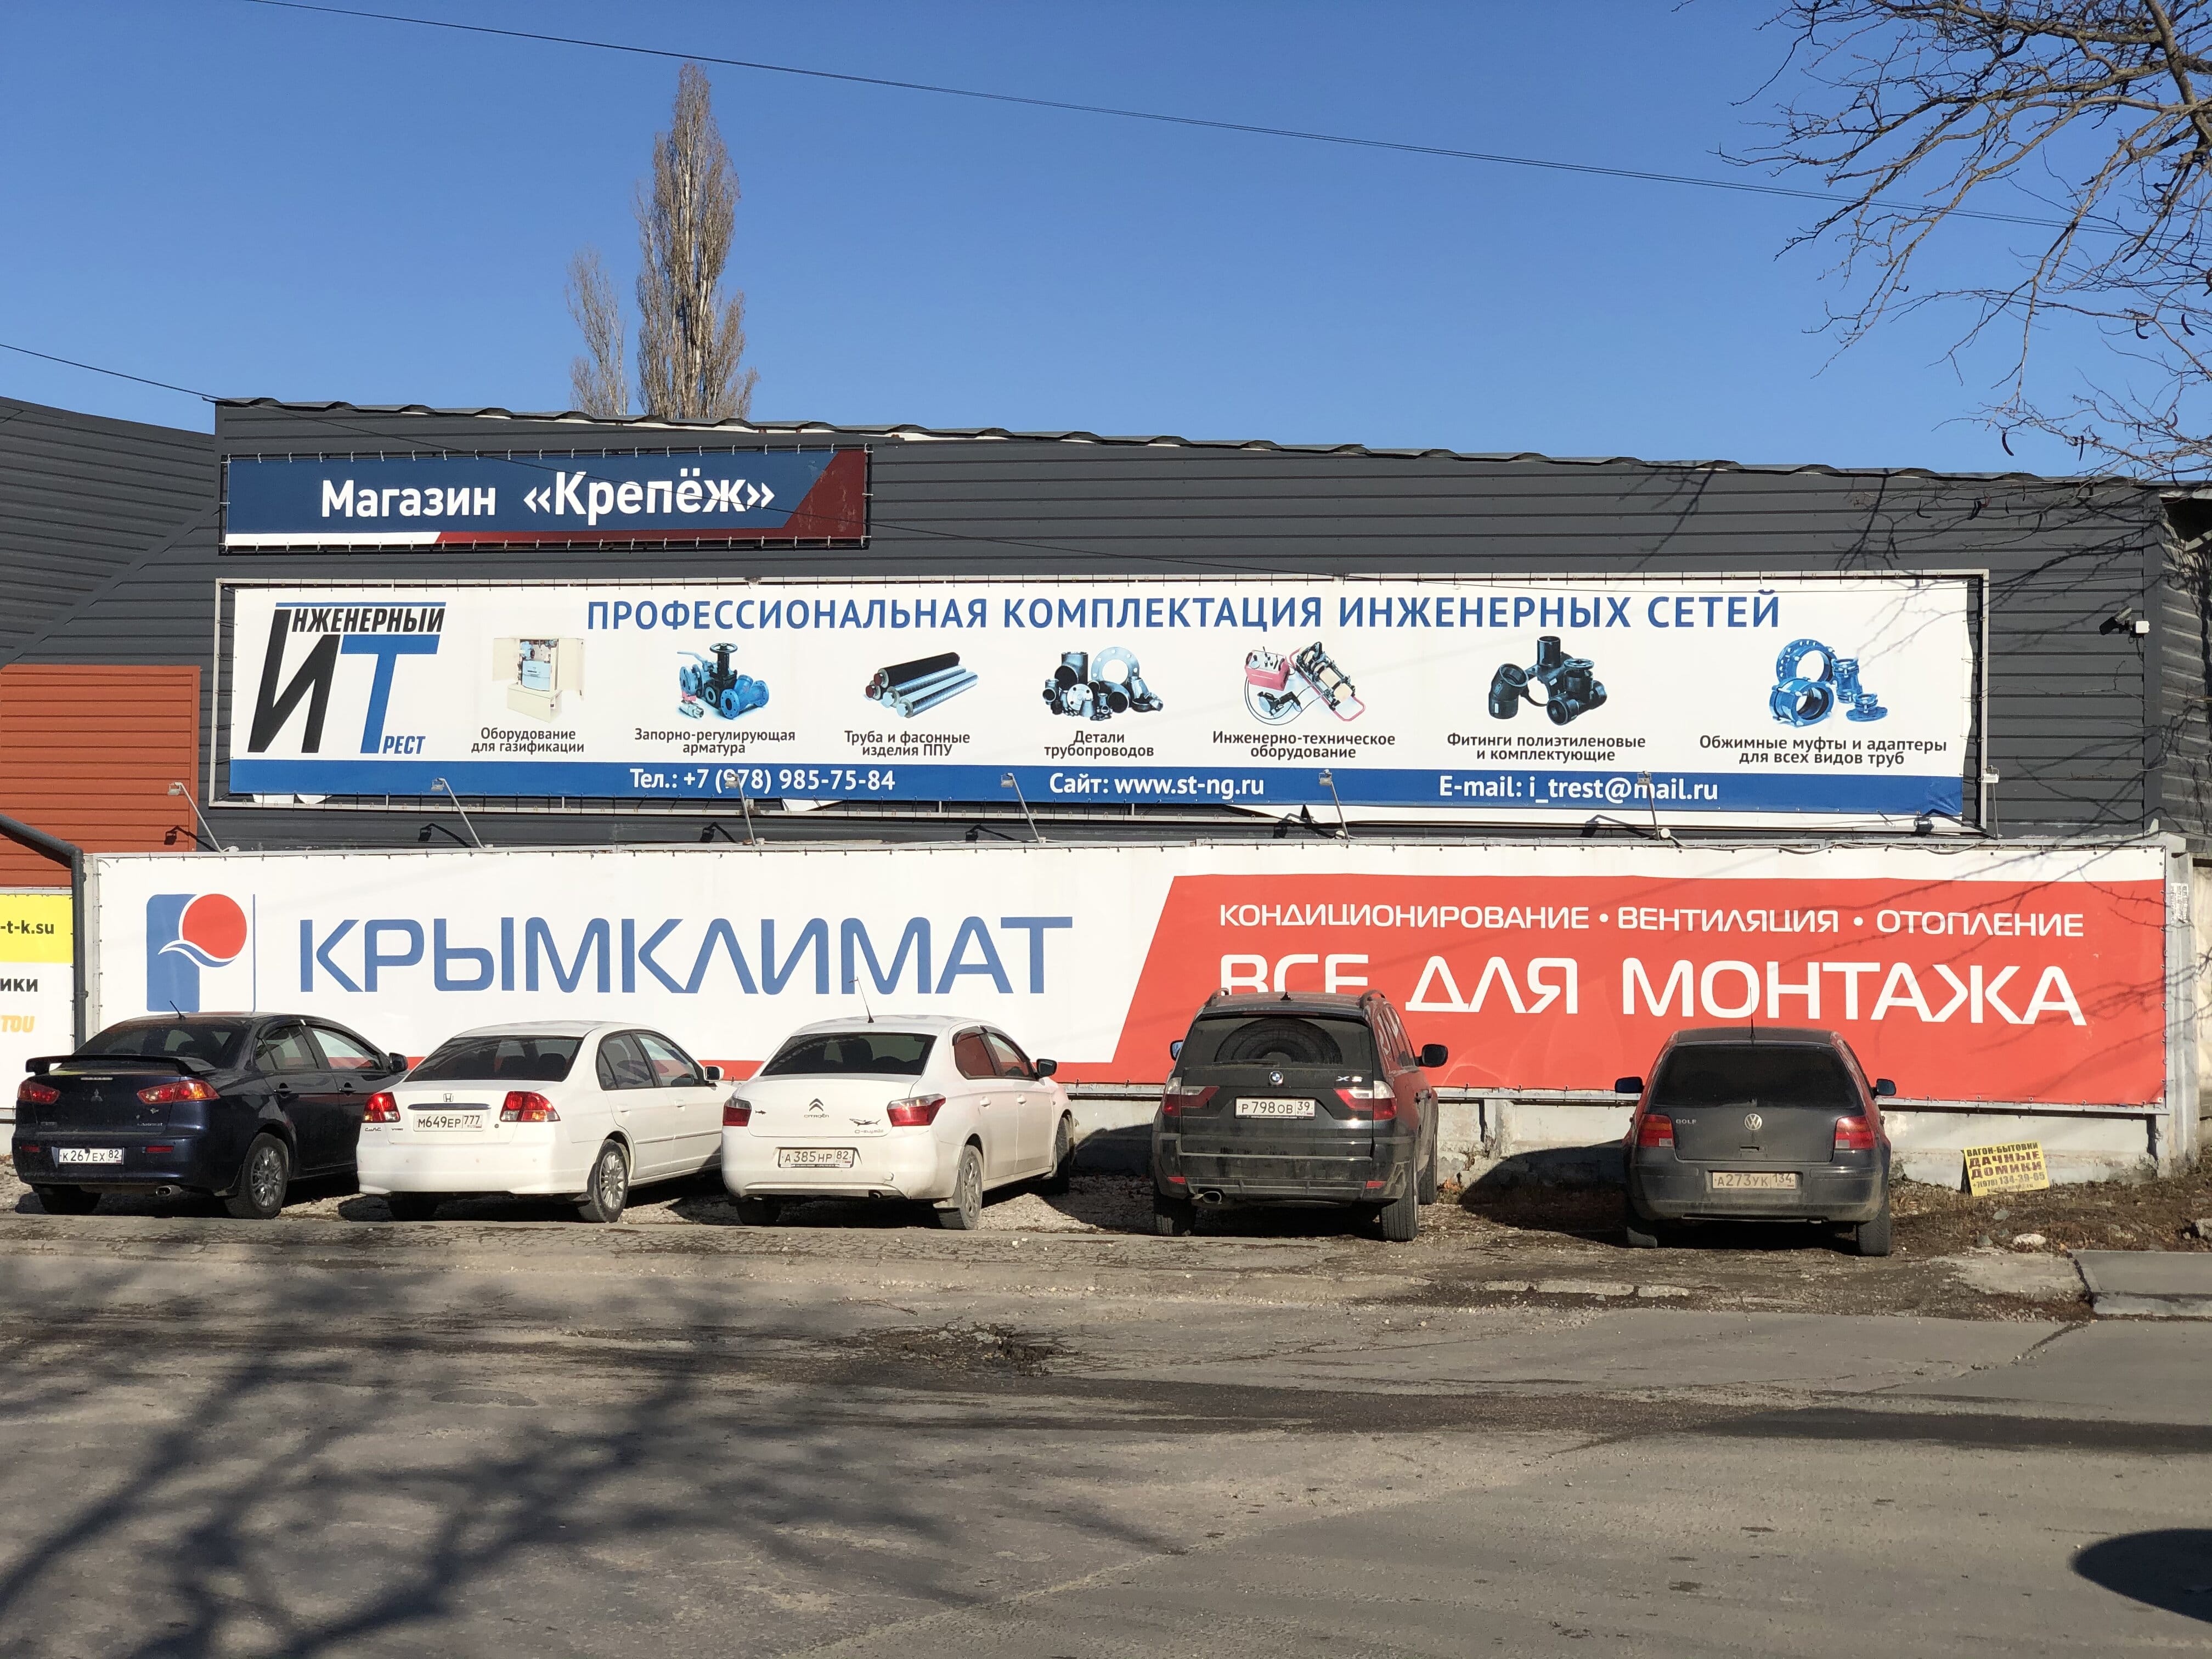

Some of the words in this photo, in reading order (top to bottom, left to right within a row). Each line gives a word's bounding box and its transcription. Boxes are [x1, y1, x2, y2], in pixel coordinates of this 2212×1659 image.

[321, 479, 495, 517] Магазин
[524, 468, 774, 525] «Крепёж»
[587, 599, 986, 630] ПРОФЕССИОНАЛЬНАЯ
[1004, 597, 1321, 632] КОМПЛЕКТАЦИЯ
[1340, 596, 1631, 628] ИНЖЕНЕРНЫХ
[1647, 589, 1779, 628] СЕТЕЙ
[481, 727, 576, 743] Оборудование
[635, 727, 795, 743] Запорно-регулирующая
[844, 730, 883, 746] Труба
[888, 734, 895, 743] и
[900, 730, 970, 747] фасонные
[1074, 730, 1125, 745] Детали
[1213, 731, 1395, 747] Инженерно-техническое
[1447, 732, 1511, 747] Фитинги
[1517, 736, 1646, 748] полиэтиленовые
[471, 743, 495, 753] для
[500, 741, 584, 755] газификации
[682, 744, 746, 757] арматура
[862, 744, 918, 758] изделия
[923, 743, 952, 756] ППУ
[1044, 744, 1154, 759] трубопроводов
[1250, 745, 1356, 760] оборудование
[1700, 735, 1787, 750] Обжимные
[1792, 737, 1847, 753] муфты
[1853, 740, 1861, 750] и
[1867, 740, 1946, 754] адаптеры
[1477, 750, 1485, 760] и
[1491, 750, 1615, 764] комплектующие
[1739, 752, 1768, 764] для
[1774, 753, 1809, 763] всех
[1814, 753, 1863, 765] видов
[1867, 752, 1904, 768] труб
[630, 768, 678, 789] Тел.:
[684, 769, 709, 789] +7
[779, 769, 895, 791] 985-75-84
[1049, 772, 1108, 794] Сайт:
[1114, 776, 1264, 800] www.st-ng.ru
[1440, 775, 1522, 797] E-mail:
[1530, 776, 1718, 804] i_trest@mail.ru
[1220, 904, 1589, 929] КОНДИЦИОНИРОВАНИЕ
[1618, 907, 1838, 933] ВЕНТИЛЯЦИЯ
[1877, 909, 2084, 937] ОТОПЛЕНИЕ
[300, 917, 1073, 995] КРЫМКЛИМАТ
[1406, 956, 1578, 1014] ДЛЯ
[1622, 957, 2087, 1025] МОНТАЖА
[1966, 1142, 2039, 1157] ВАГОН-БЫТОВКИ
[1969, 1150, 2041, 1169] ДАЧНЫЕ
[1971, 1161, 2042, 1180] ДОМИКИ
